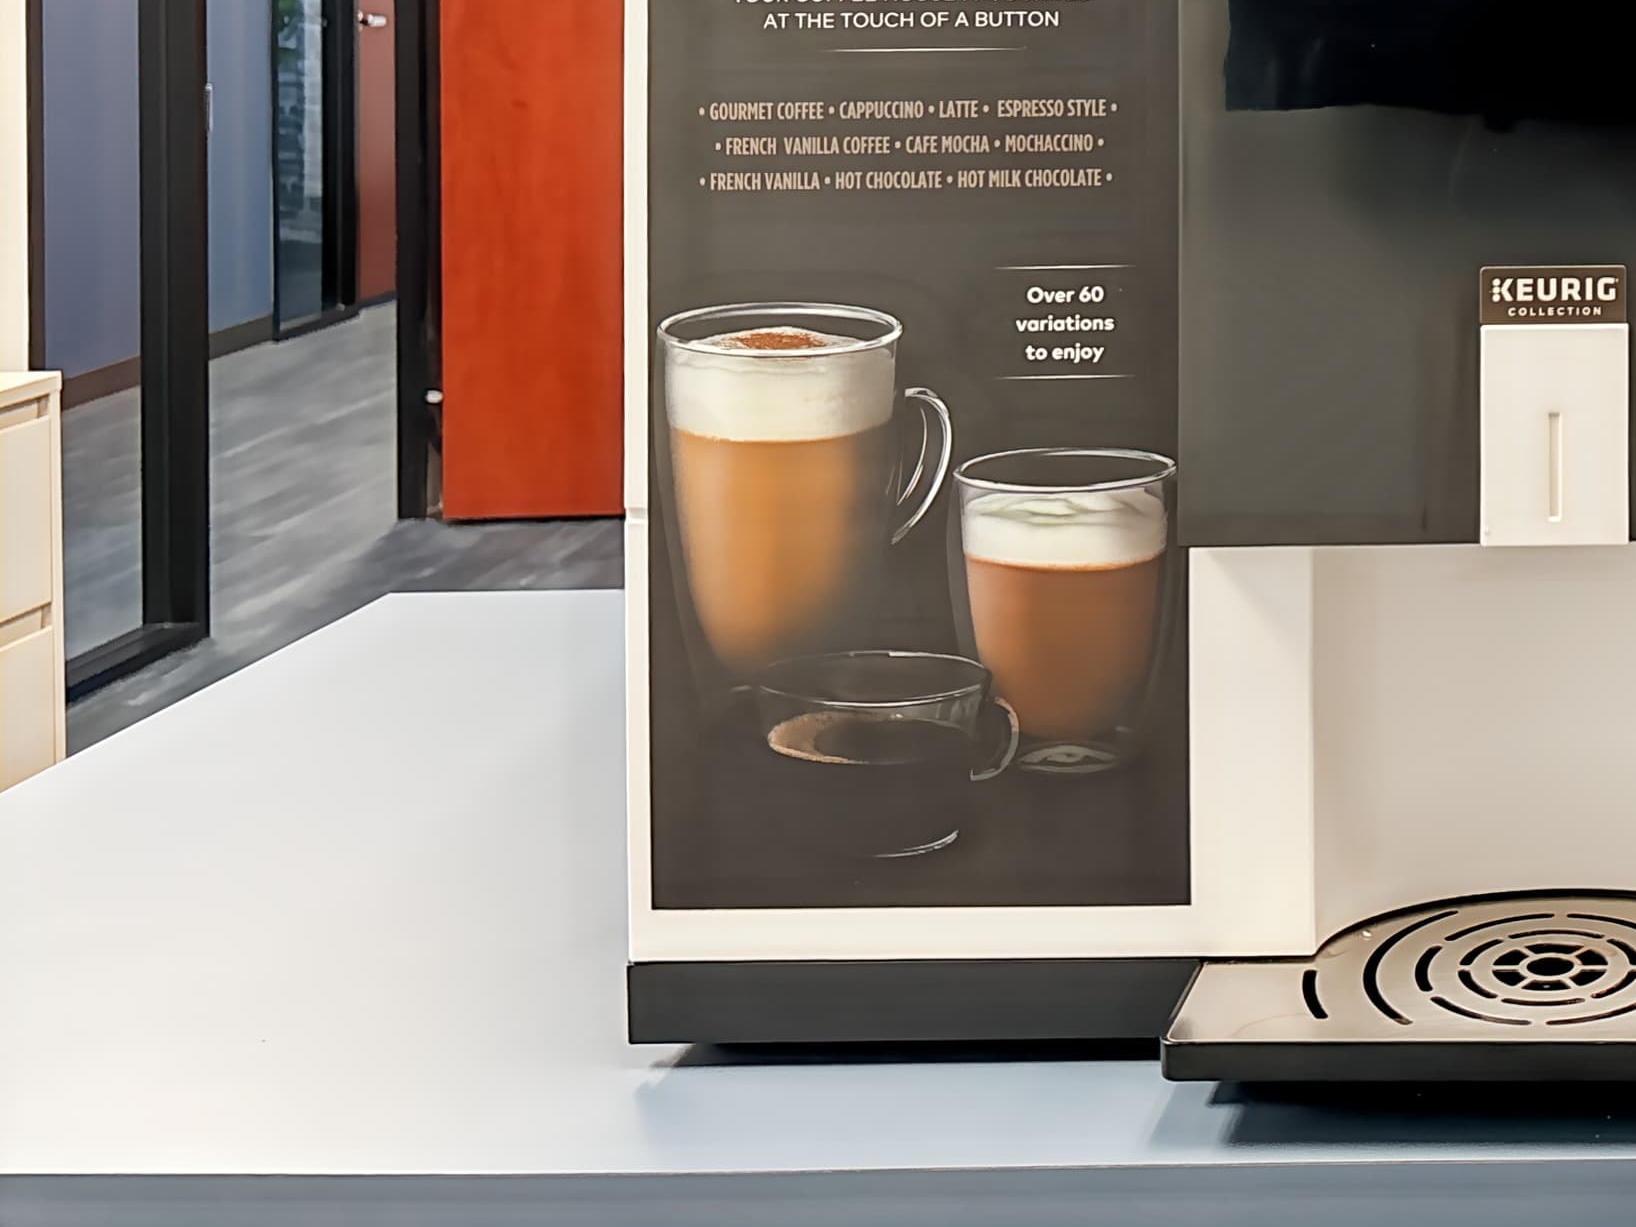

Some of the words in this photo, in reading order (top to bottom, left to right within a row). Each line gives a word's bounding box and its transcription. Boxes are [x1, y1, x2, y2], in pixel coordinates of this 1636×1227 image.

[763, 13, 789, 29] AT
[795, 13, 835, 29] THE
[840, 12, 914, 29] TOUCH
[921, 11, 949, 28] OF
[954, 11, 969, 27] A
[976, 11, 1060, 27] BUTTON
[709, 102, 773, 121] GOURMET
[777, 101, 824, 120] COFFEE
[839, 100, 924, 120] CAPPUCCINO
[939, 100, 978, 118] LATTE
[997, 99, 1064, 118] ESPRESSO
[1067, 98, 1107, 117] STYLE
[725, 137, 777, 156] FRENCH
[784, 136, 840, 155] VANILLA
[843, 136, 891, 155] COFFEE
[905, 135, 938, 154] CAFE
[941, 135, 990, 154] MOCHA
[1005, 133, 1093, 153] MOCHACCINO
[710, 172, 761, 191] FRENCH
[765, 171, 820, 191] VANILLA
[835, 171, 862, 190] HOT
[866, 170, 943, 190] CHOCOLATE
[957, 169, 985, 189] HOT
[988, 169, 1021, 188] MILK
[1024, 168, 1102, 187] CHOCOLATE
[1027, 286, 1075, 304] Over
[1079, 285, 1104, 303] 60
[1492, 277, 1617, 303] KEURIG
[1508, 306, 1602, 317] COLLECTION
[1016, 314, 1115, 332] variations
[1025, 345, 1048, 361] to
[1051, 342, 1105, 364] enjoy
